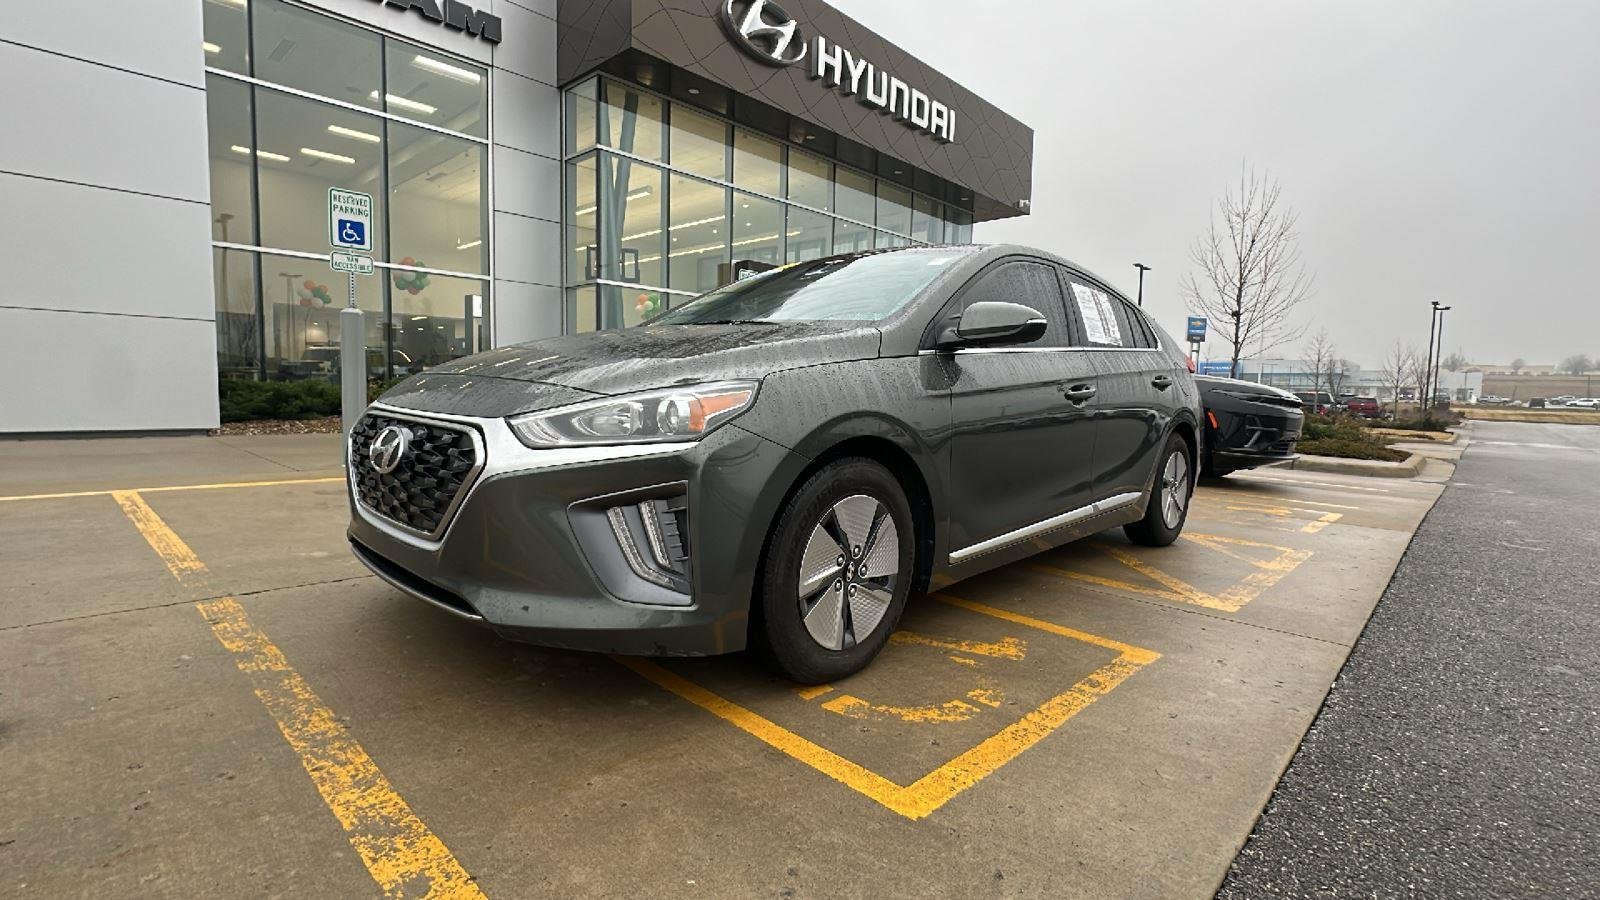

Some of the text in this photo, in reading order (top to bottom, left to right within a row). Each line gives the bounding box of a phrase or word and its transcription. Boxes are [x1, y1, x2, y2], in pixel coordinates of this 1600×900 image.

[364, 0, 502, 44] AM
[814, 35, 956, 143] HYUNDAI
[333, 194, 368, 208] RESERVED
[333, 204, 369, 217] PARKING
[334, 261, 372, 271] ACCESSIBLE
